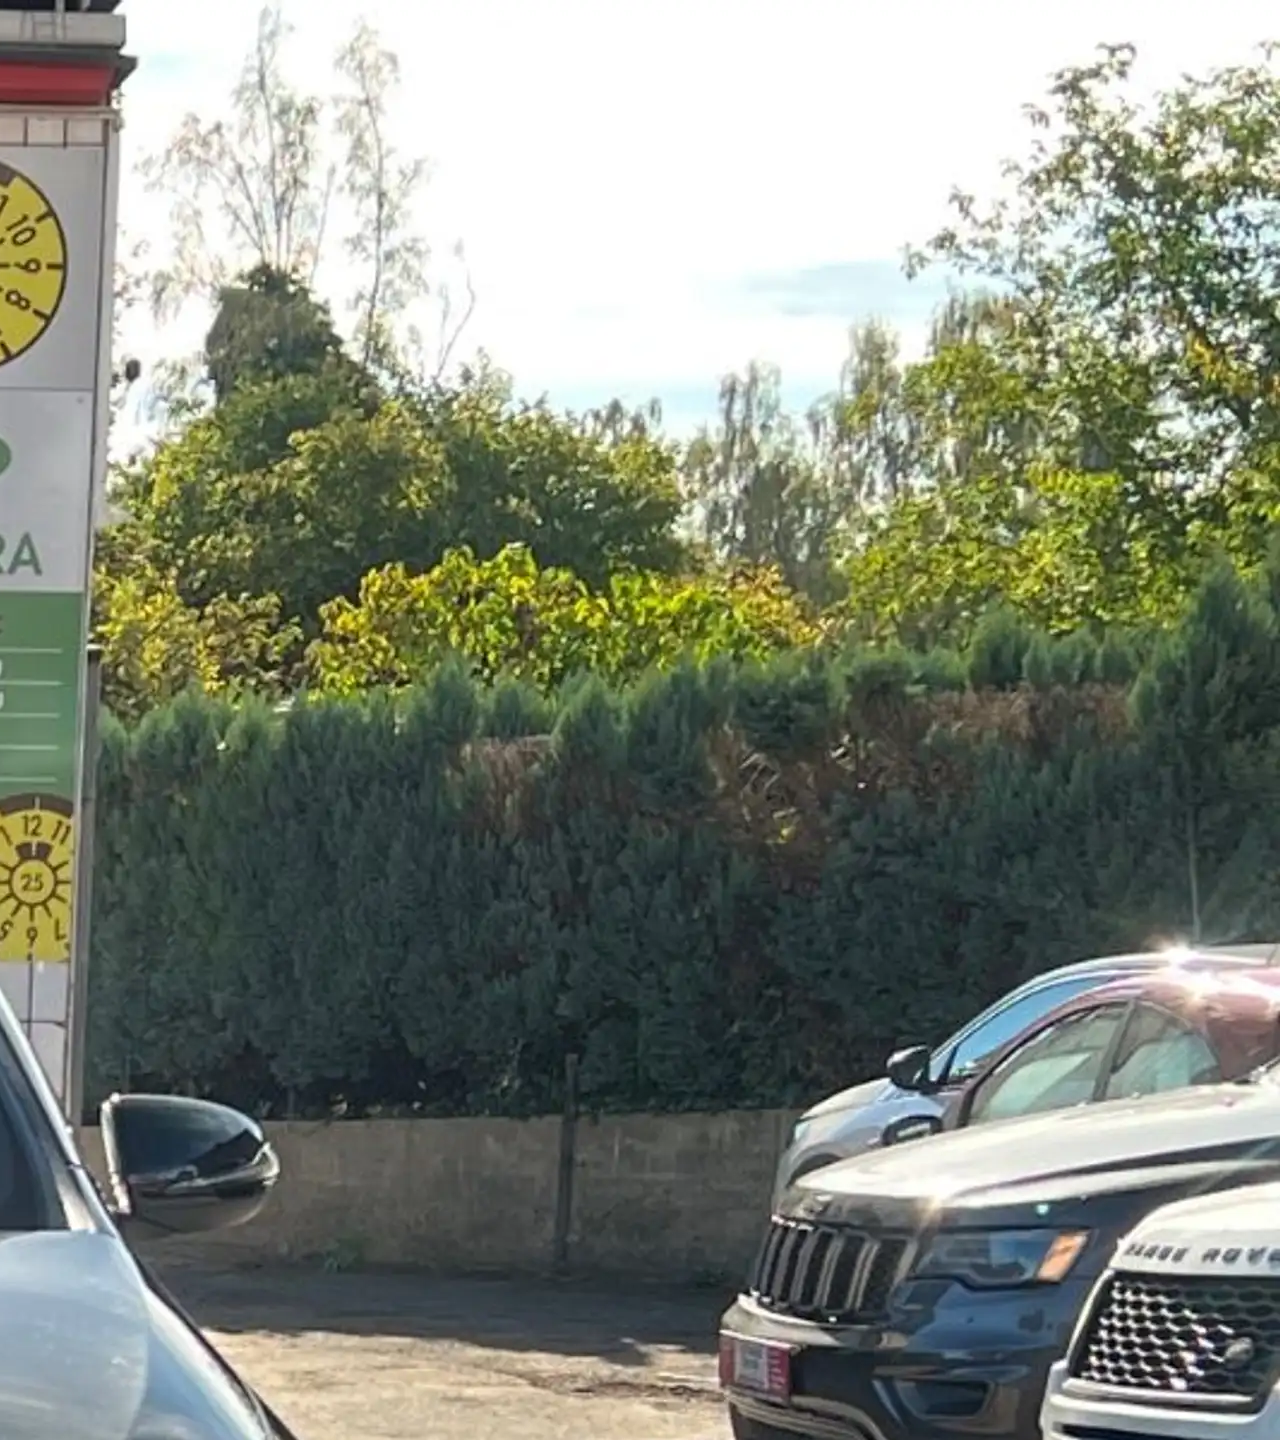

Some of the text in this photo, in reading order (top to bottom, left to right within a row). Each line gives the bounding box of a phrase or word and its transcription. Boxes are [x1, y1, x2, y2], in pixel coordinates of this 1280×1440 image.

[5, 214, 37, 246] 10
[5, 289, 31, 310] 8
[22, 815, 42, 837] 12
[51, 820, 71, 846] 11
[20, 872, 44, 892] 25
